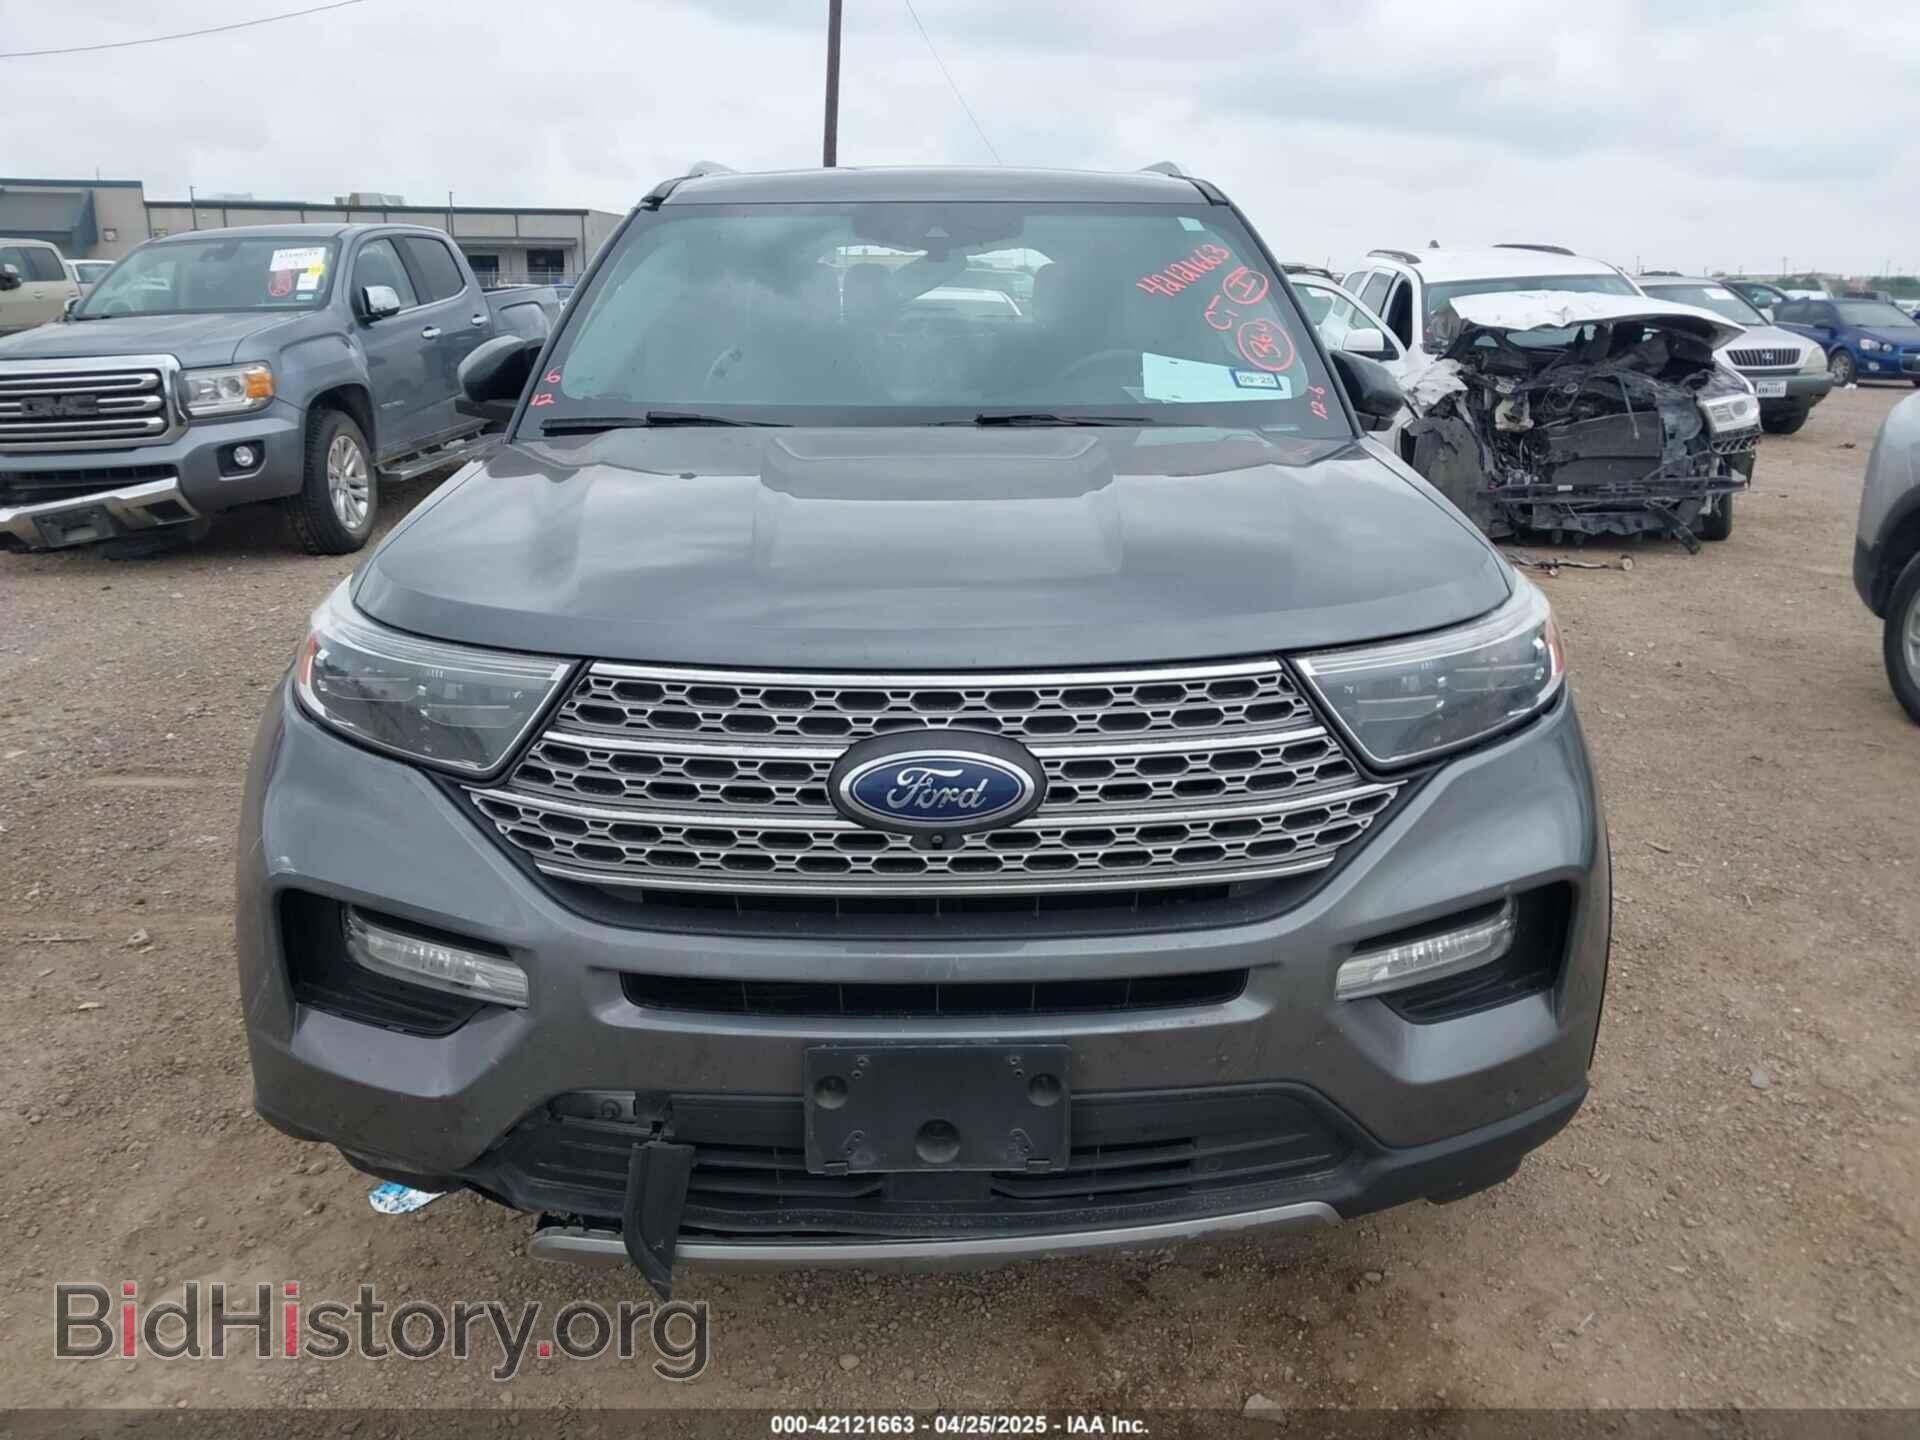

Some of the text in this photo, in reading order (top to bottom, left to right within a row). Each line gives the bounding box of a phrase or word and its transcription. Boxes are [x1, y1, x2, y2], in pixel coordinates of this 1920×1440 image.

[20, 394, 99, 417] GMC
[530, 393, 555, 407] 12
[886, 767, 988, 809] Ford
